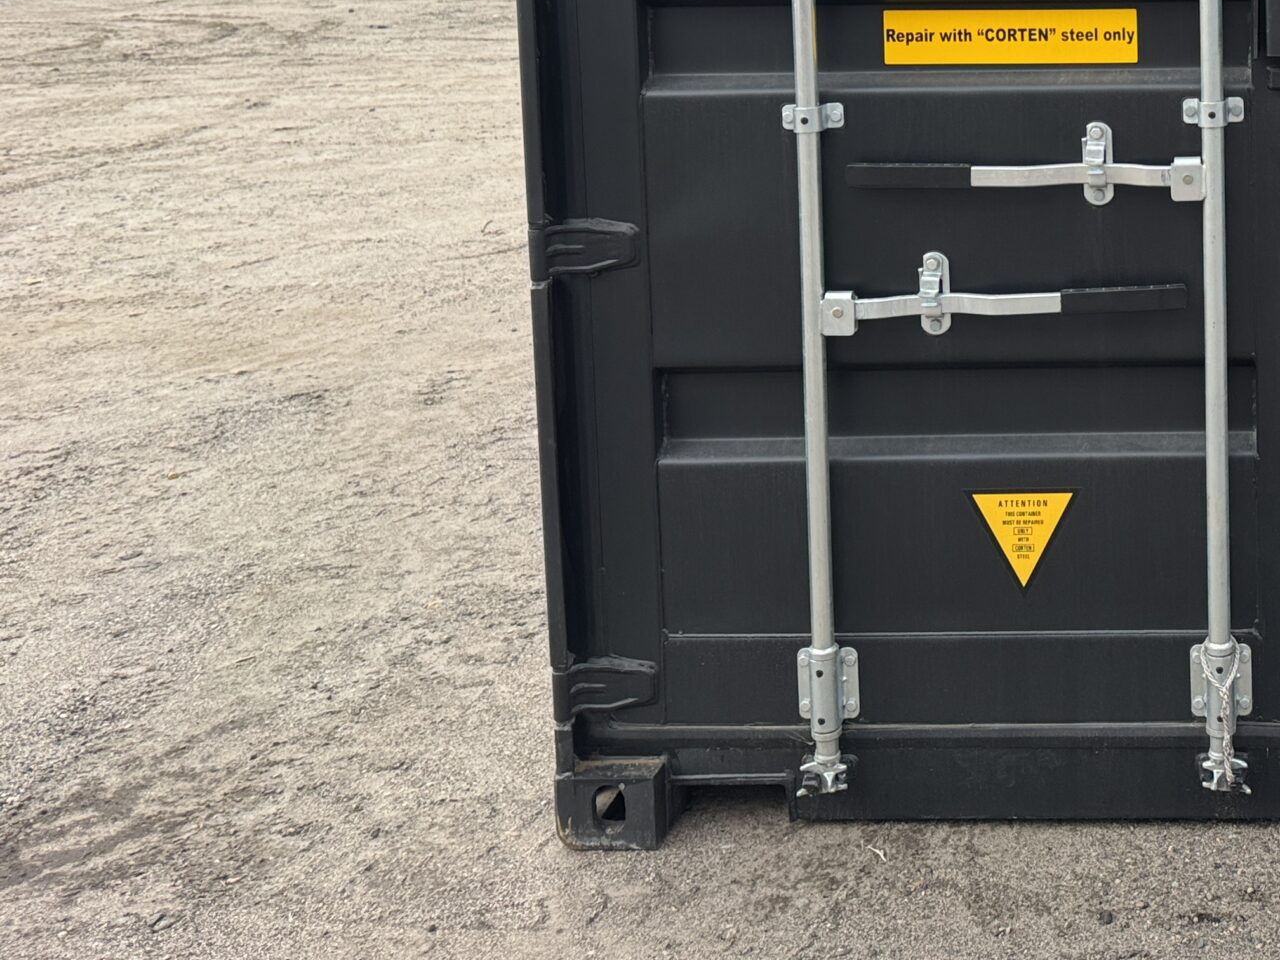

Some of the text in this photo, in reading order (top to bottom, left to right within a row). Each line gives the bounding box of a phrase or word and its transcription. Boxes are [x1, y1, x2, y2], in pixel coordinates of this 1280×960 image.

[886, 27, 1135, 46] Repair with “CORTEN” steel only
